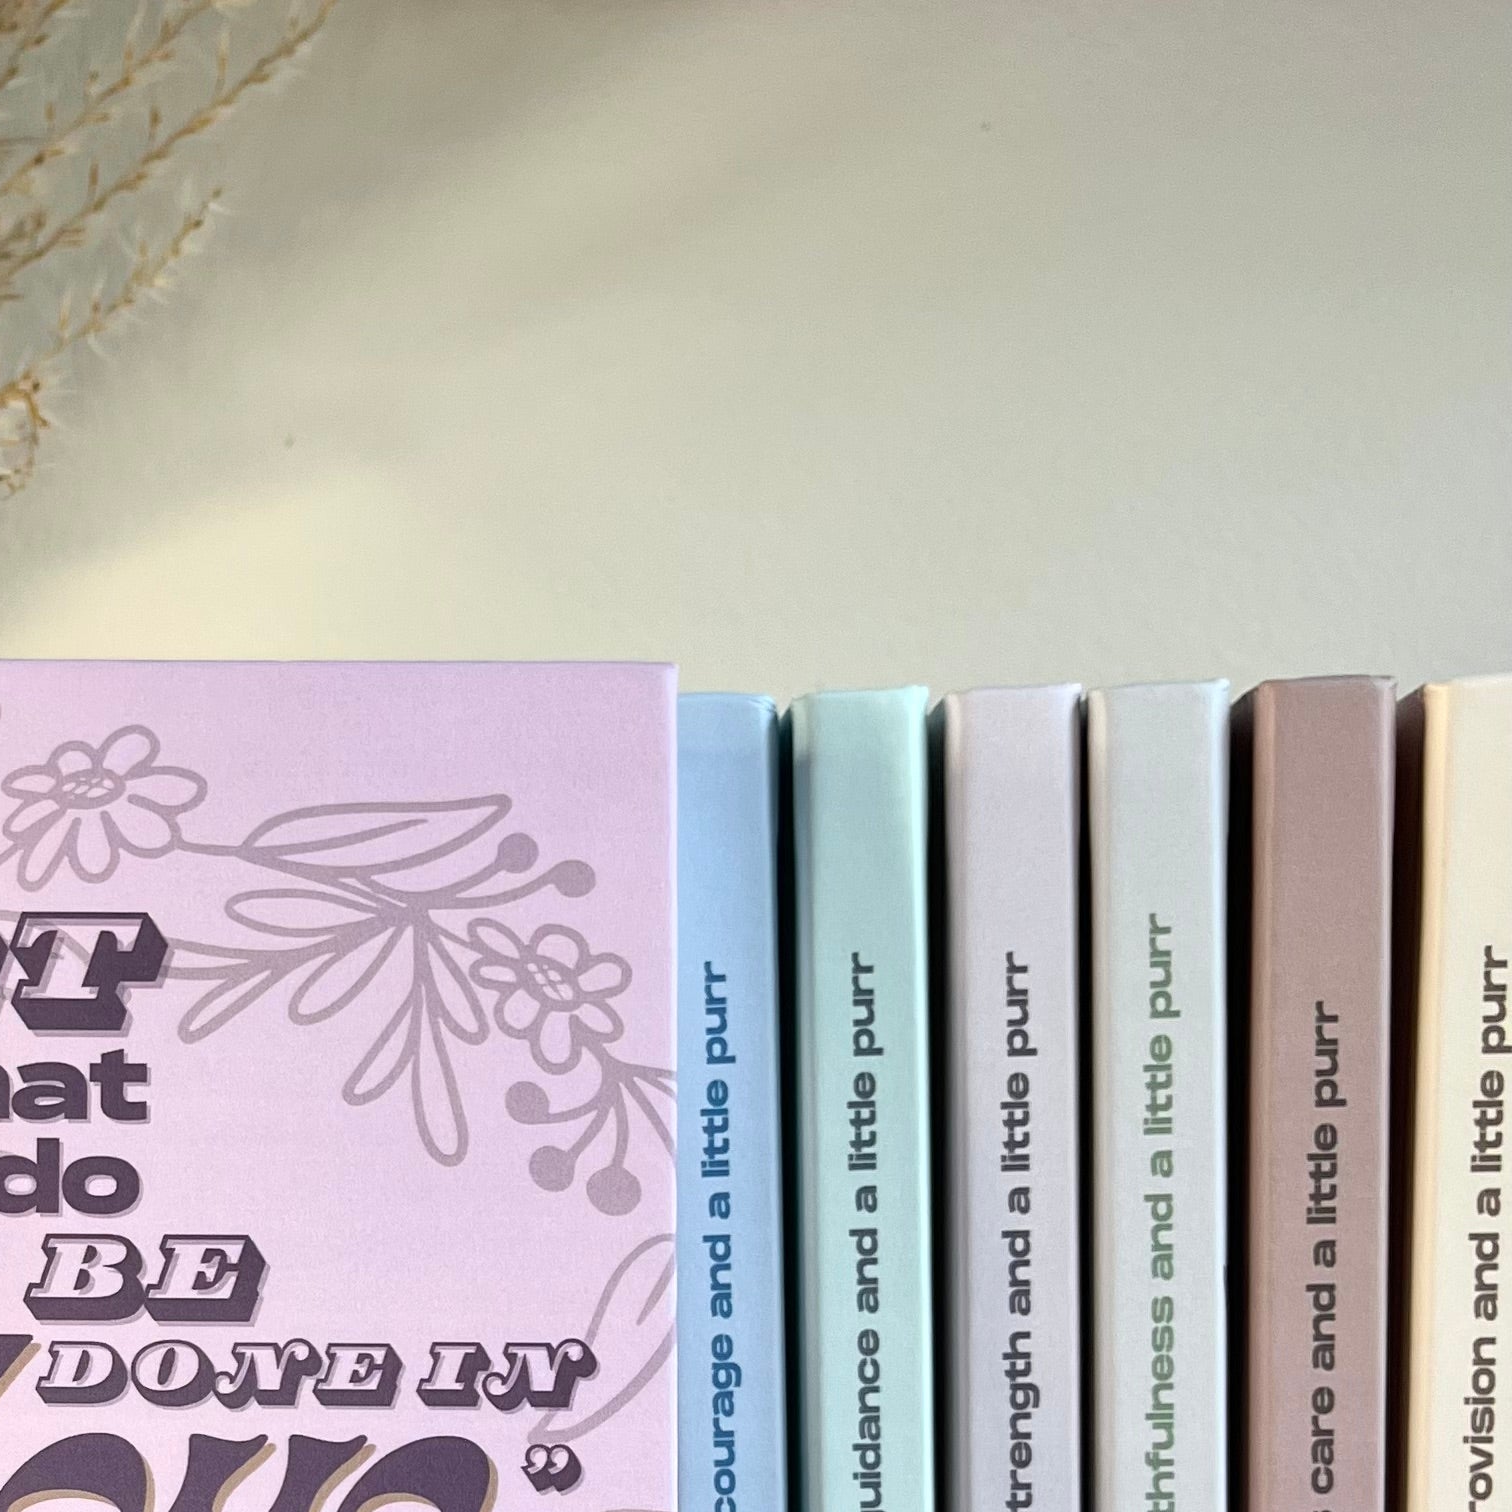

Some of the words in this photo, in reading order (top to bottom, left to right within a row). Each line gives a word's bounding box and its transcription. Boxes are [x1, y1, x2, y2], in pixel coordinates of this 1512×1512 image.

[851, 952, 884, 1057] purr
[1005, 951, 1038, 1057] purr
[1149, 913, 1181, 1019] purr
[1481, 945, 1512, 1055] purr
[704, 961, 736, 1065] purr
[1314, 1001, 1347, 1108] purr
[700, 1079, 730, 1178] little
[846, 1072, 877, 1171] little
[1000, 1072, 1031, 1172] little
[1143, 1035, 1173, 1135] little
[1470, 1070, 1505, 1173] little
[709, 1192, 731, 1219] a
[855, 1185, 878, 1213] a
[1008, 1186, 1032, 1215] a
[1150, 1150, 1174, 1178] a
[1306, 1123, 1338, 1225] little
[1476, 1188, 1501, 1217] a
[23, 1233, 268, 1323] BE
[702, 1234, 733, 1319] and
[849, 1228, 880, 1314] and
[1001, 1229, 1032, 1316] and
[1144, 1193, 1174, 1280] and
[1313, 1239, 1337, 1268] a
[1468, 1232, 1500, 1321] and
[1305, 1283, 1336, 1371] and
[36, 1339, 402, 1408] DONE
[416, 1340, 597, 1410] IN
[1311, 1386, 1335, 1495] care
